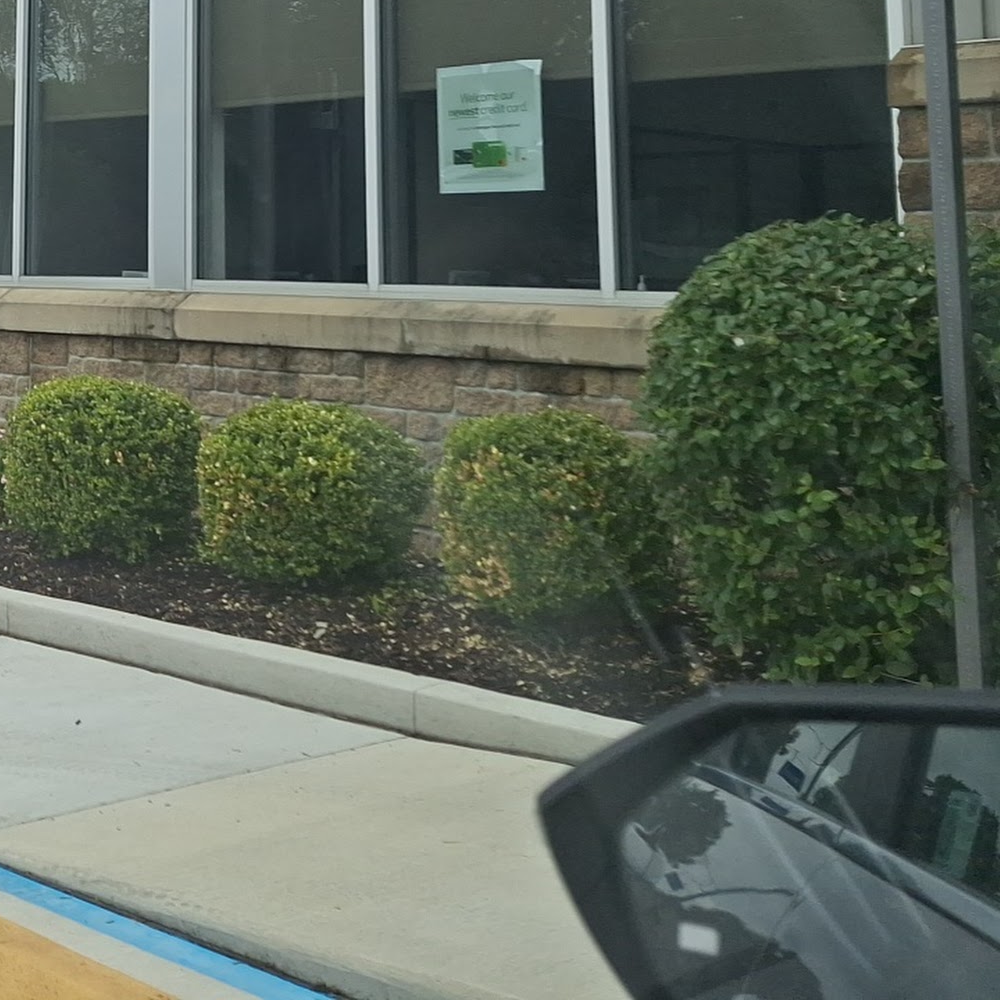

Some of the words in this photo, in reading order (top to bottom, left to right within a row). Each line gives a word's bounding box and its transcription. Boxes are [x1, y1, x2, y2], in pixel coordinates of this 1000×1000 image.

[460, 91, 499, 103] Welcome
[500, 90, 515, 101] our
[480, 103, 505, 115] credit
